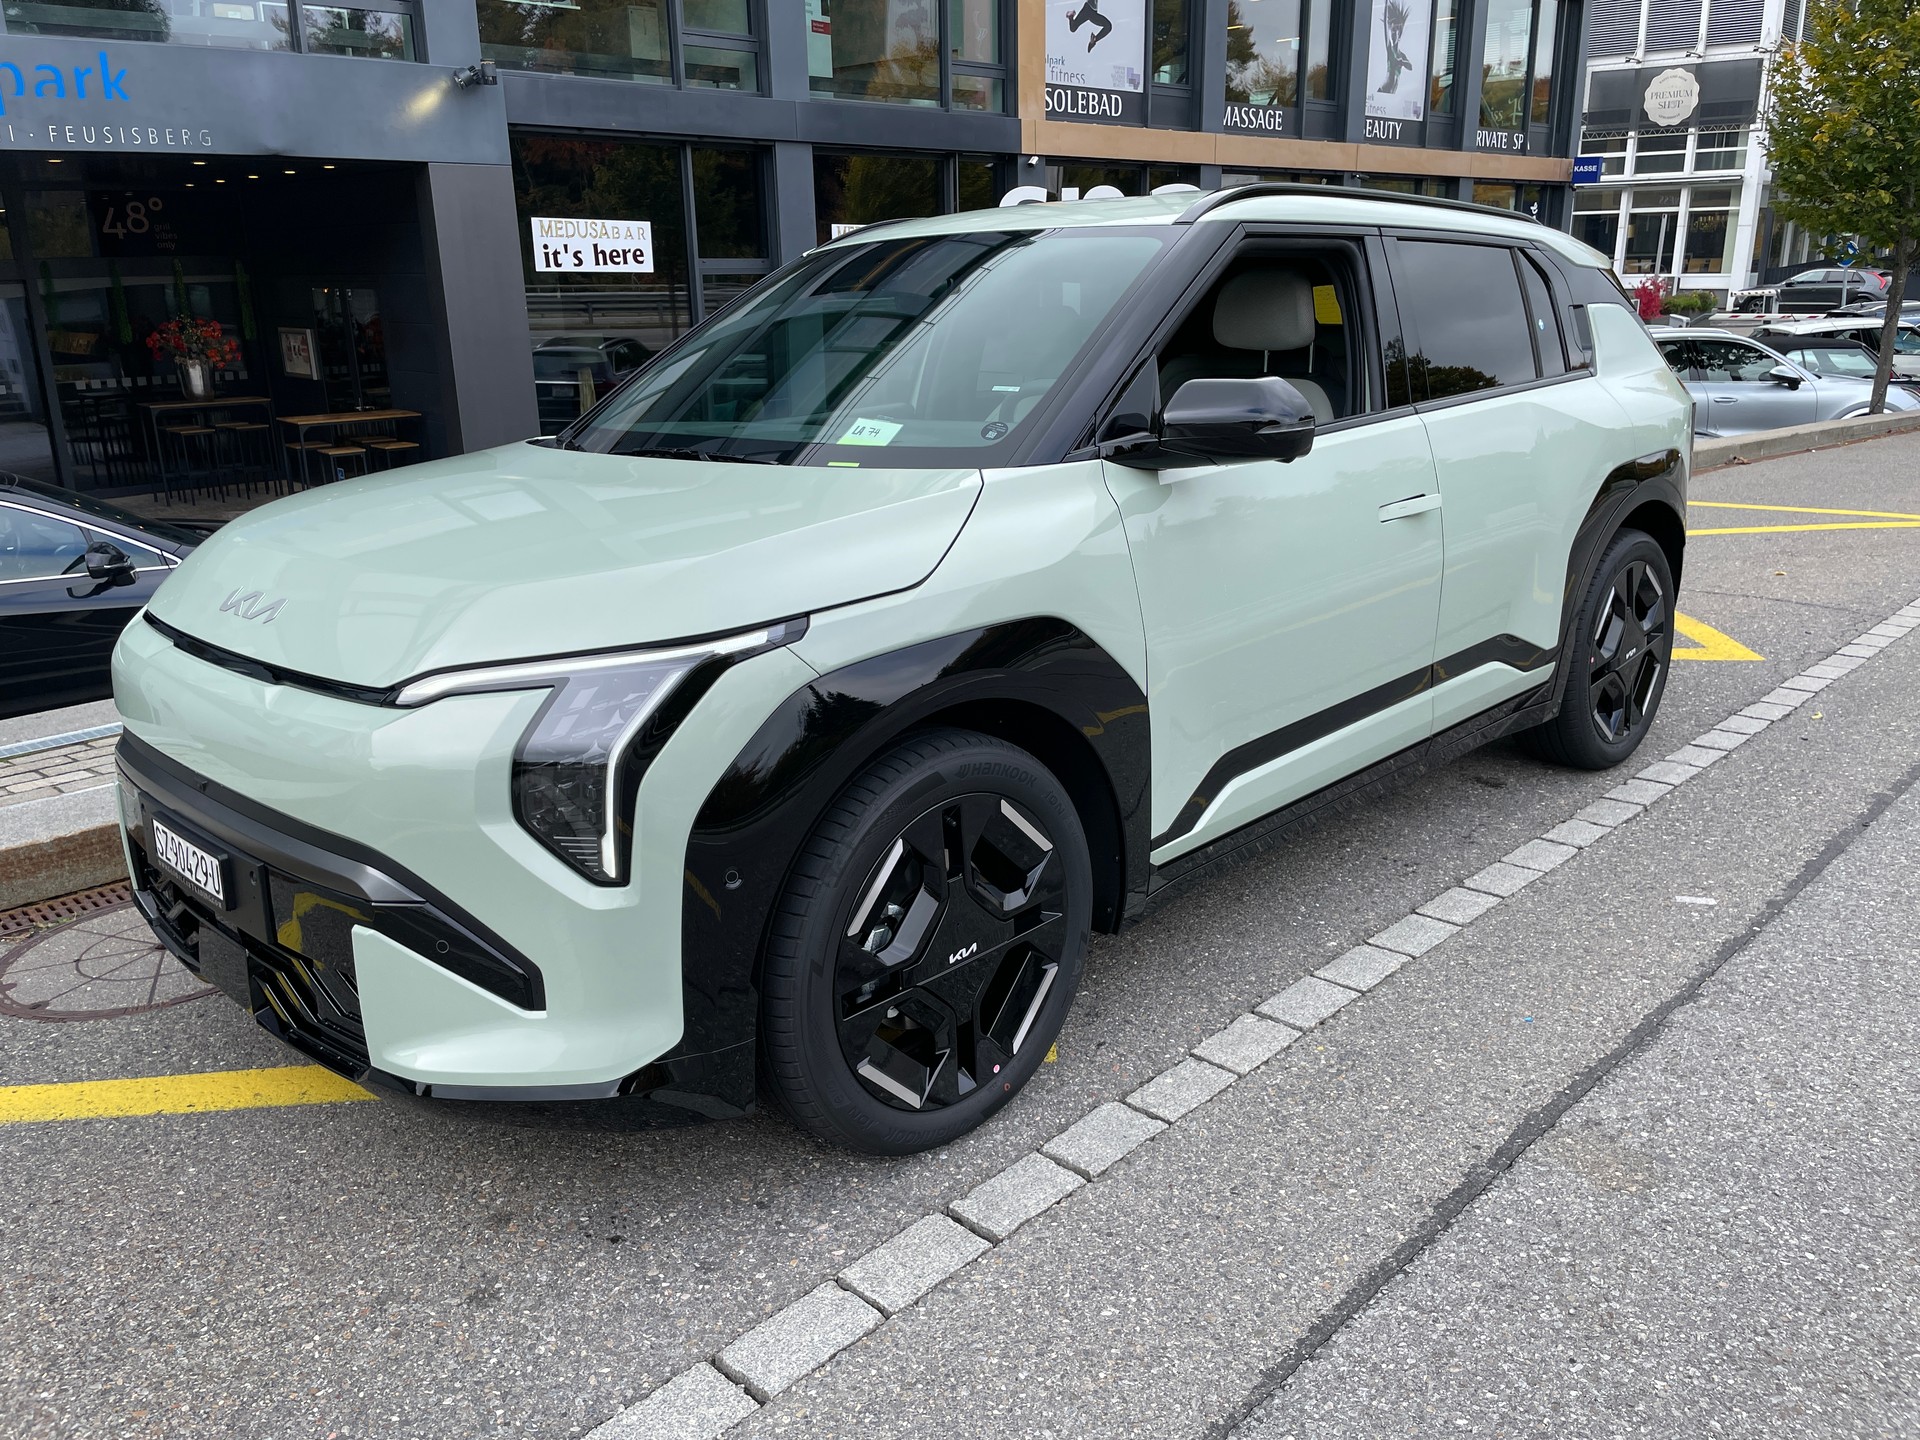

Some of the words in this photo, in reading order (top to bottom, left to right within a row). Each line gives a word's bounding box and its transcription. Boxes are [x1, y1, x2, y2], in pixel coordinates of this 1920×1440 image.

[1051, 66, 1086, 85] fitness
[1045, 88, 1122, 117] SOLEBAD
[1651, 89, 1693, 100] PREMIUM
[48, 125, 212, 147] FEUSISBERG
[1574, 164, 1598, 172] KASSE
[156, 240, 176, 251] only
[542, 243, 584, 269] it's
[592, 243, 645, 267] here
[219, 585, 289, 625] KIA
[948, 942, 978, 965] KIA
